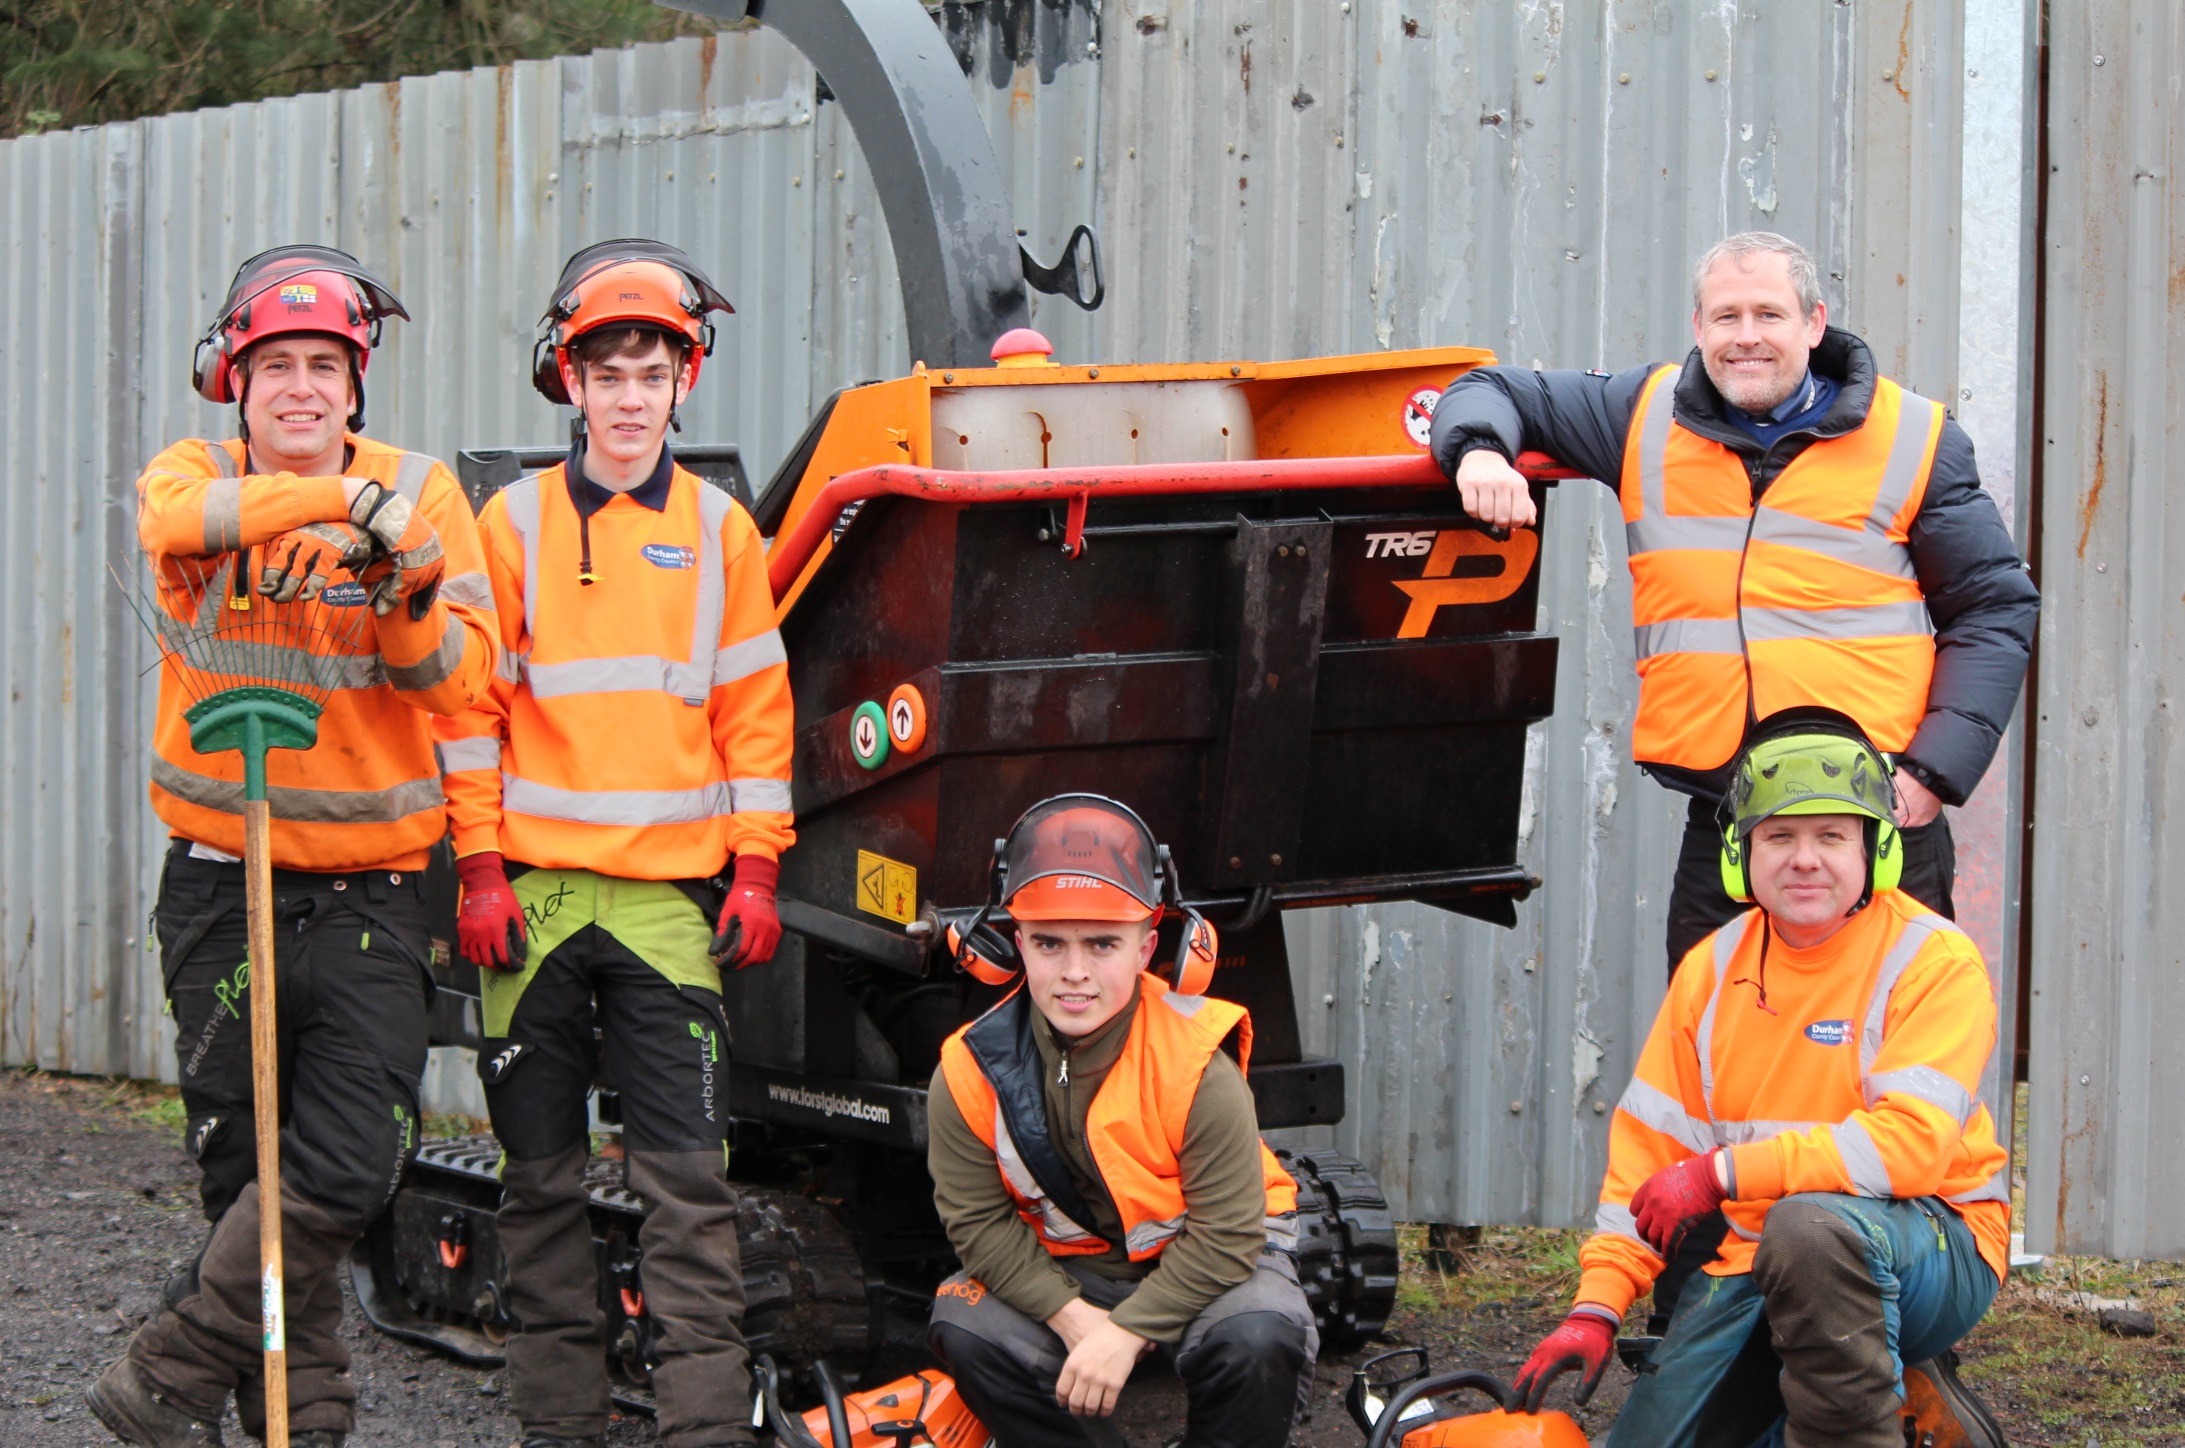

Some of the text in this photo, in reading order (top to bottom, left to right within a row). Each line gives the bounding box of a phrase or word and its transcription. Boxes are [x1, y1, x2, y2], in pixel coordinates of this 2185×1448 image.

[619, 293, 644, 302] PETZL
[287, 303, 313, 315] PETZL
[1365, 530, 1437, 558] TR6
[646, 546, 680, 560] Durham
[1055, 876, 1103, 889] STIHL
[768, 1083, 890, 1125] www.forstglobal.com
